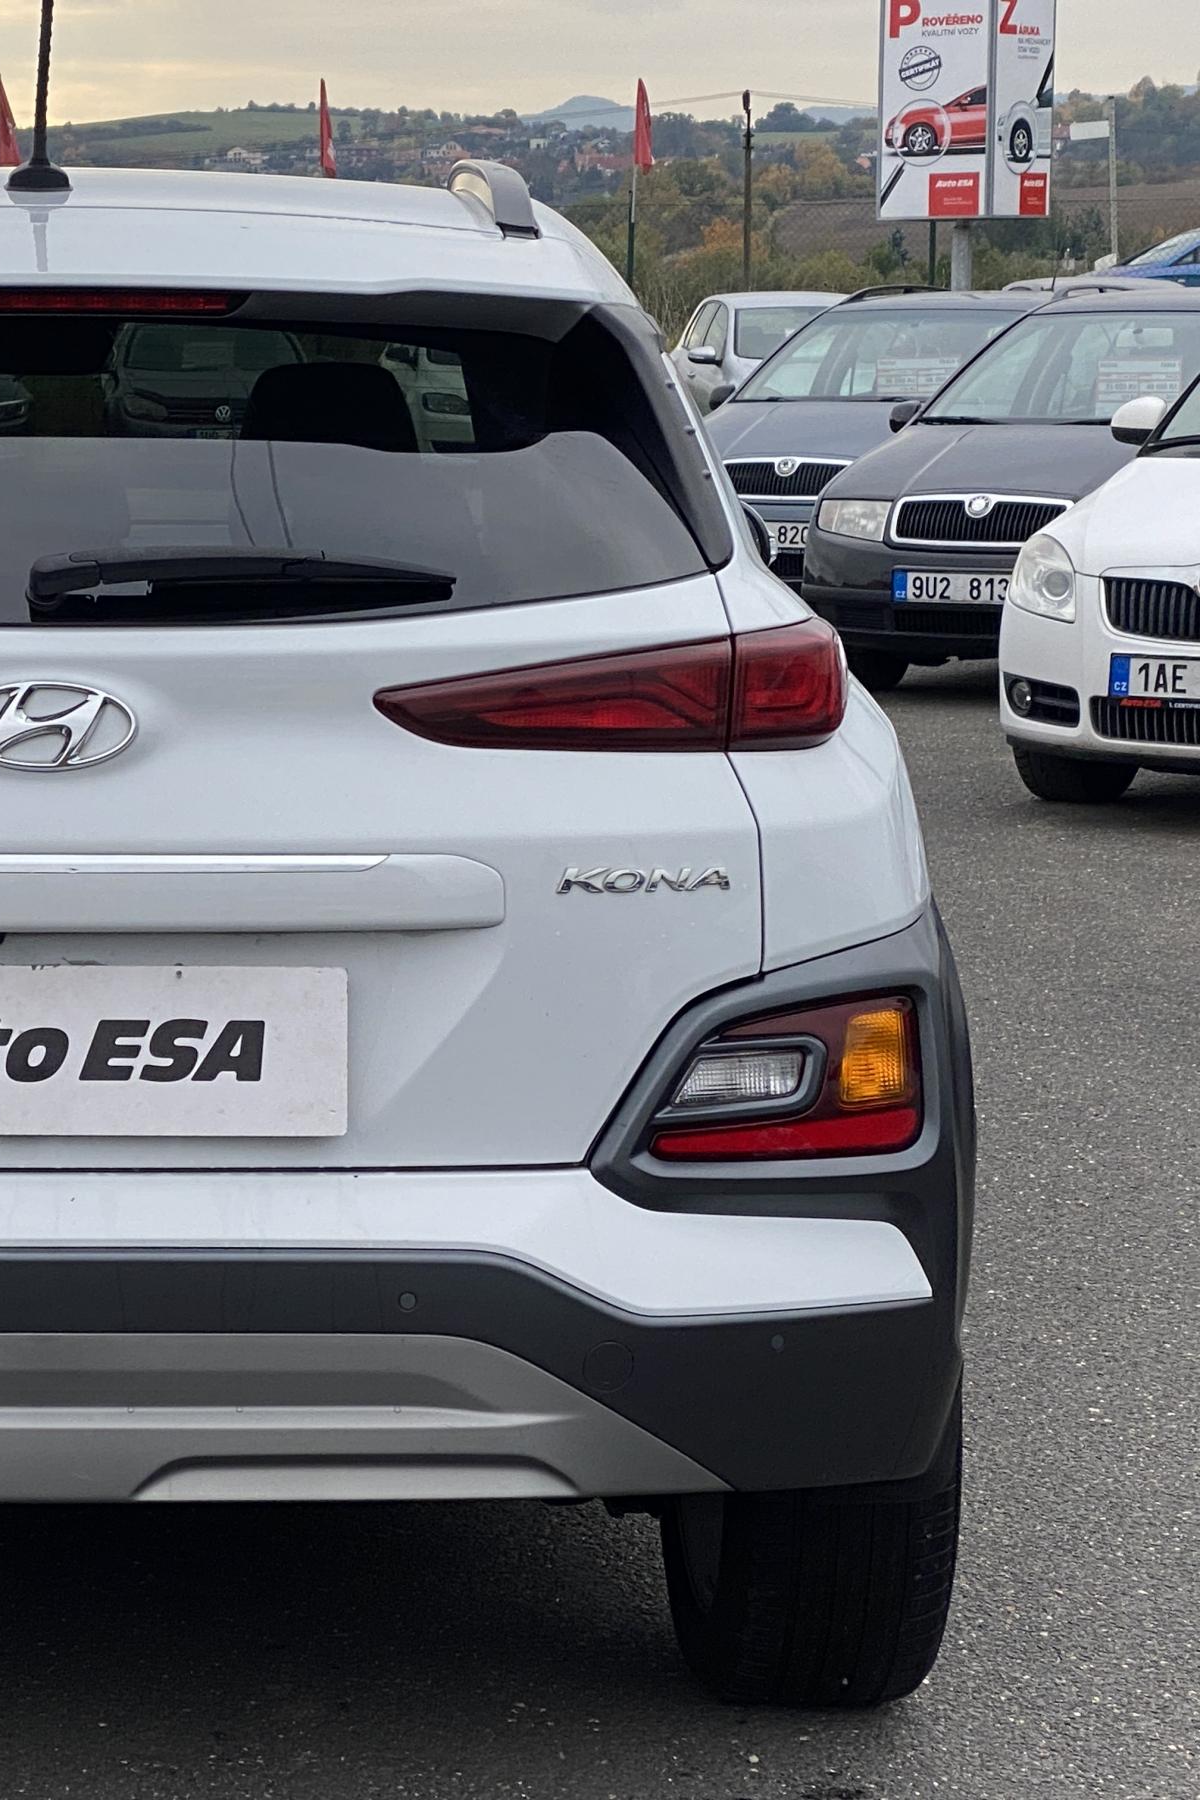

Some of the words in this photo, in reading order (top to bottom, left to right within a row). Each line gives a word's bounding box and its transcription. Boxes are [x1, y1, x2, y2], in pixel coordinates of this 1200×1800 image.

[912, 576, 951, 600] 9U2
[1113, 681, 1128, 692] CZ
[1137, 662, 1188, 694] 1AE
[555, 866, 731, 895] KONA
[78, 1018, 266, 1083] ESA
